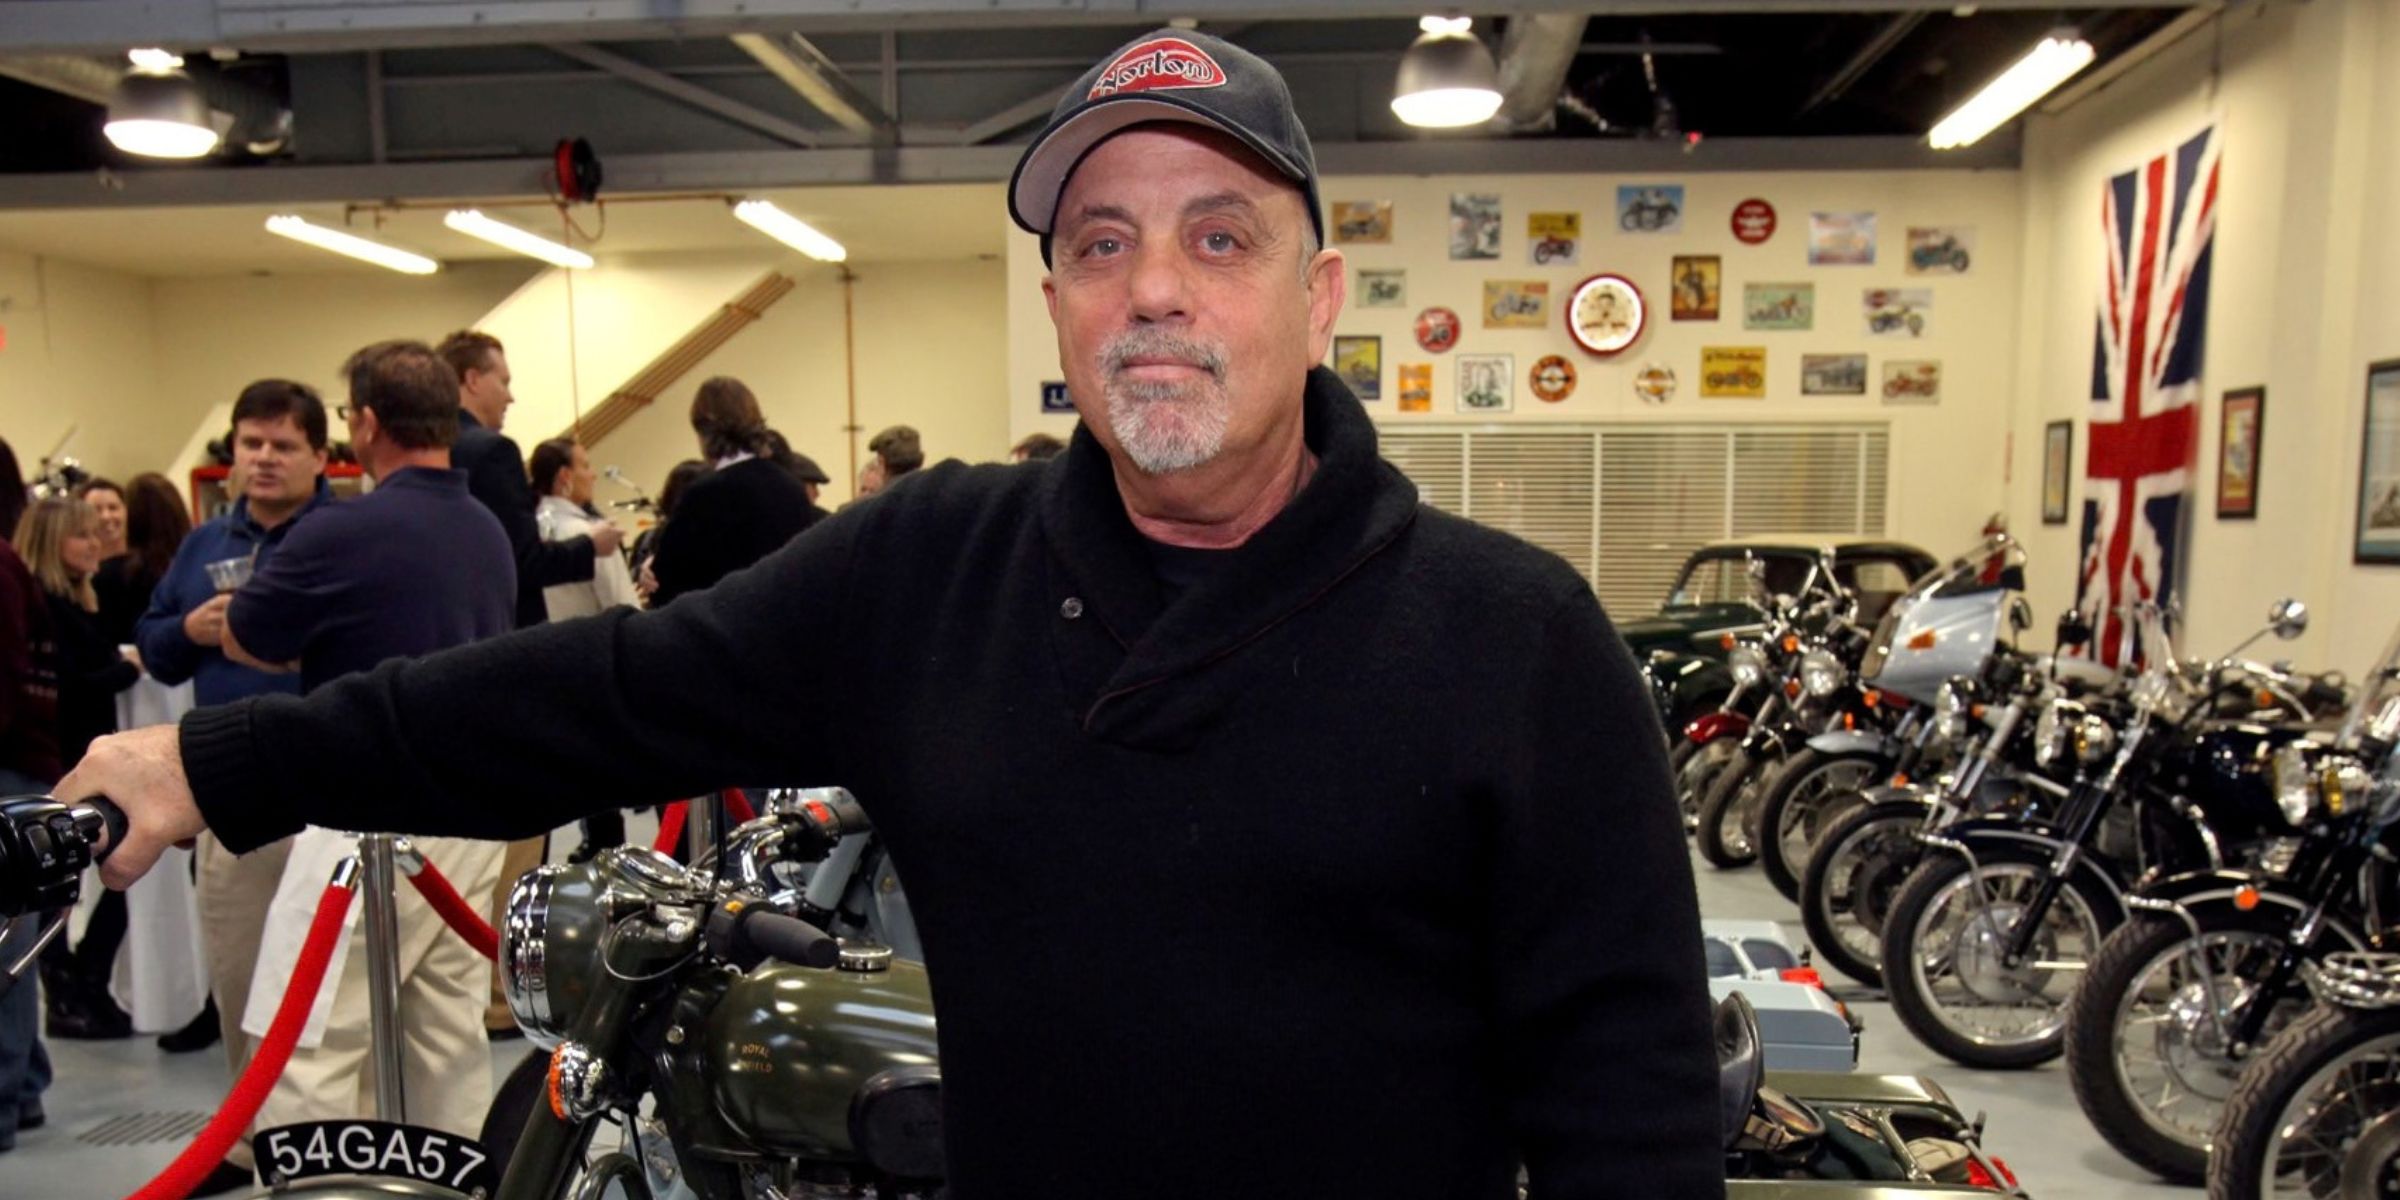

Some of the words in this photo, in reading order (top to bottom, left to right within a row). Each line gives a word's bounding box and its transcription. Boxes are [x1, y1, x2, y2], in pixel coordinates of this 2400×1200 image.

[1096, 49, 1214, 96] Norton
[742, 1043, 769, 1058] ROYAL
[269, 1125, 487, 1187] 54GA57
